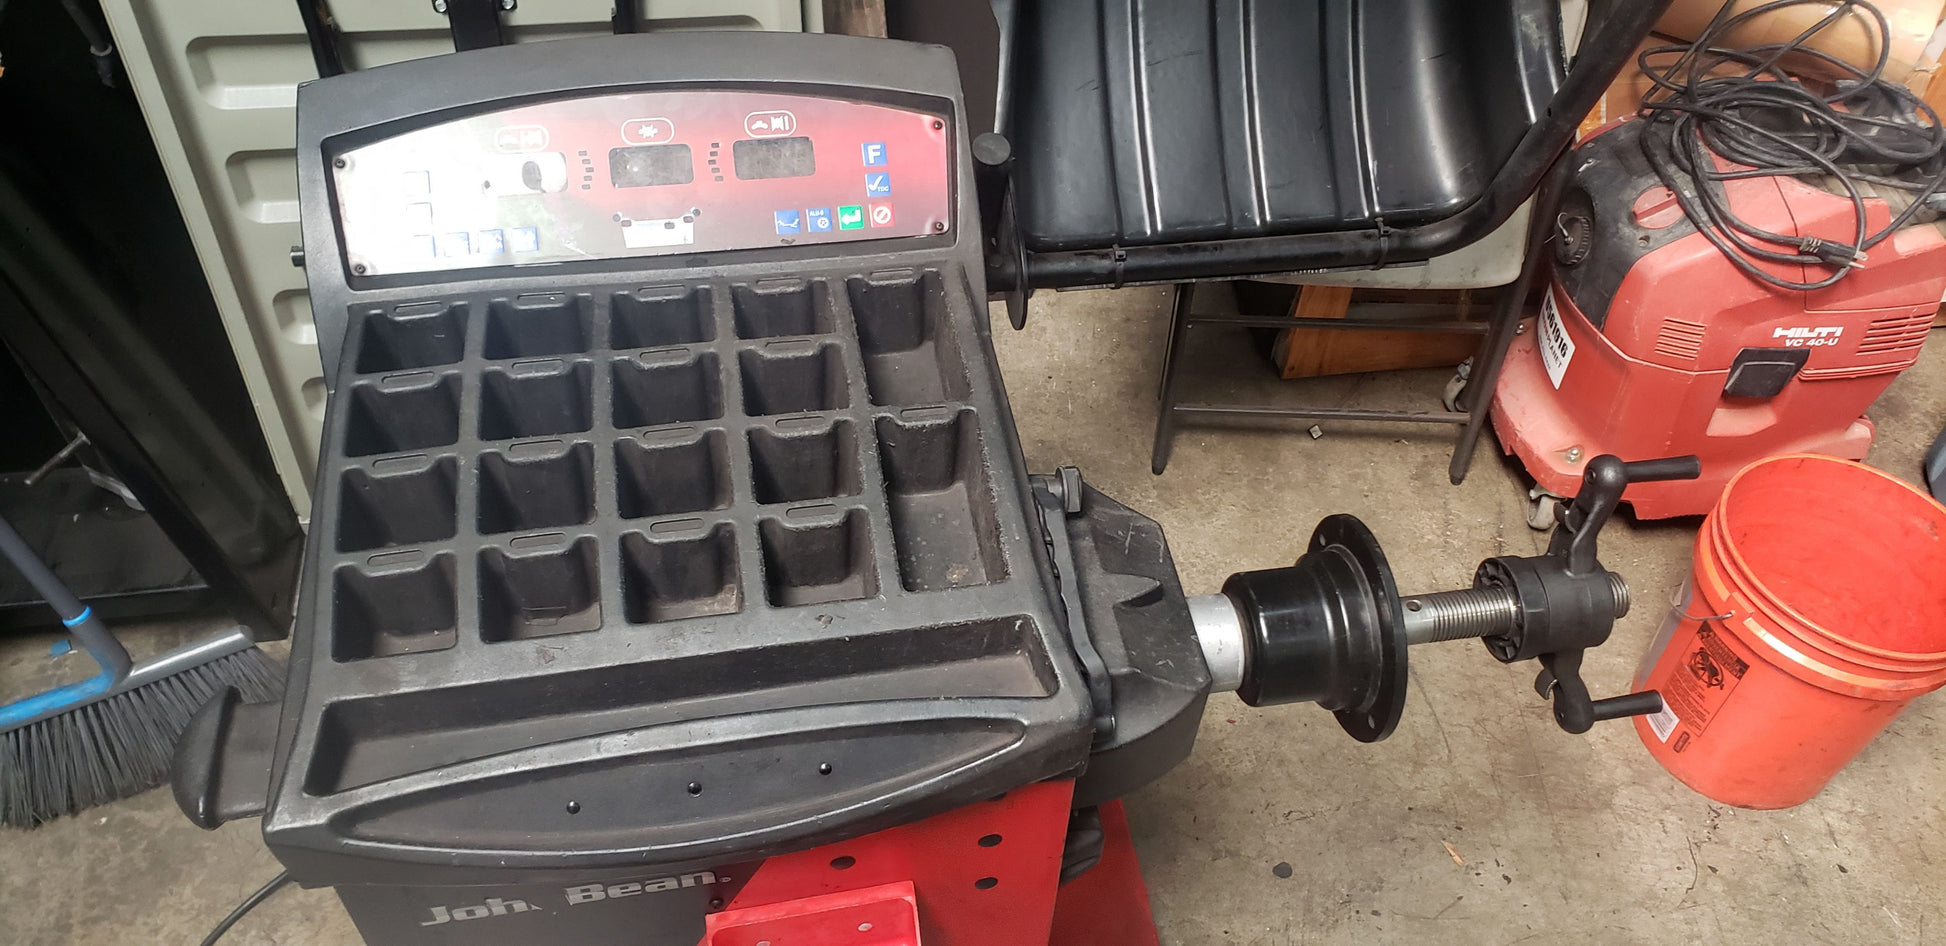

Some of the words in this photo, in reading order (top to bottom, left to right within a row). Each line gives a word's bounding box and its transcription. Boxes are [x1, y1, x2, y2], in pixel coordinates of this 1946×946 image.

[867, 144, 881, 164] F
[1773, 326, 1844, 338] HILTI
[1785, 338, 1804, 347] VC
[1806, 337, 1839, 346] 40-U
[421, 897, 543, 927] Joh
[564, 870, 717, 907] Bean
